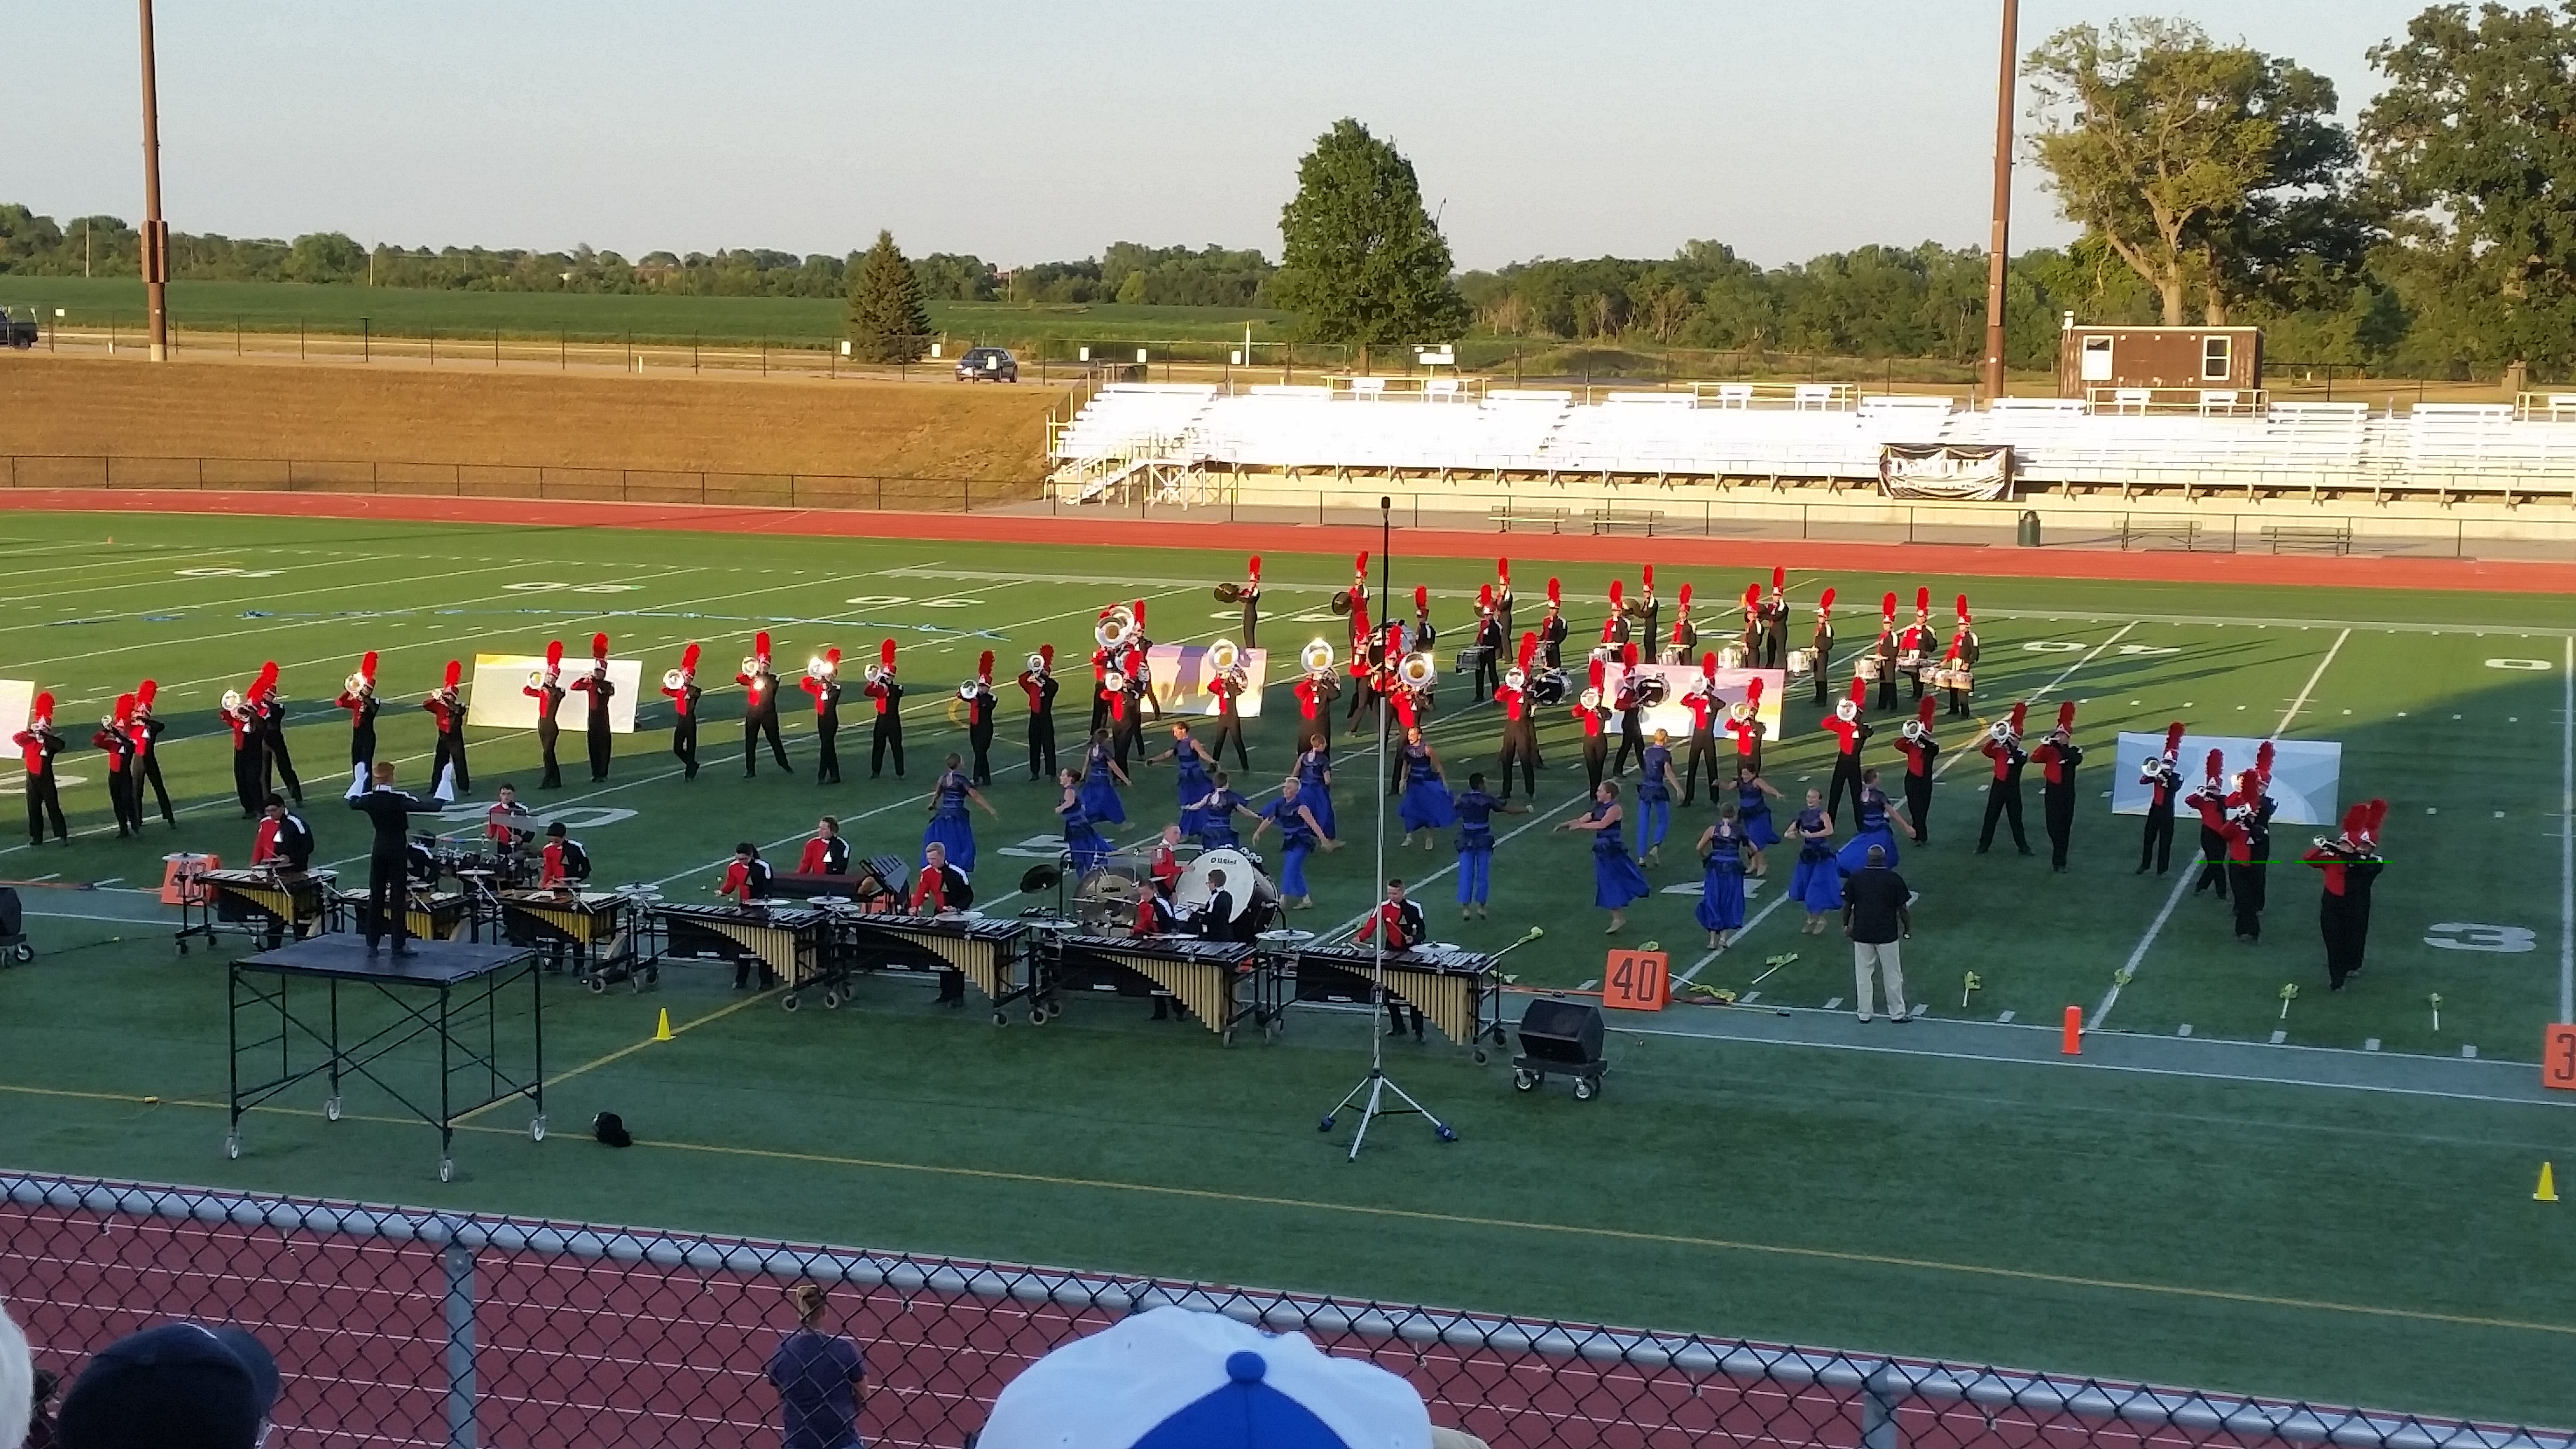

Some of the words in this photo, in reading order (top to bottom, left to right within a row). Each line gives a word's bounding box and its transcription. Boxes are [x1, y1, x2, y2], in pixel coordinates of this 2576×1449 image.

[2424, 922, 2537, 952] 3
[1612, 957, 1658, 1001] 40
[2554, 1033, 2576, 1080] 3
